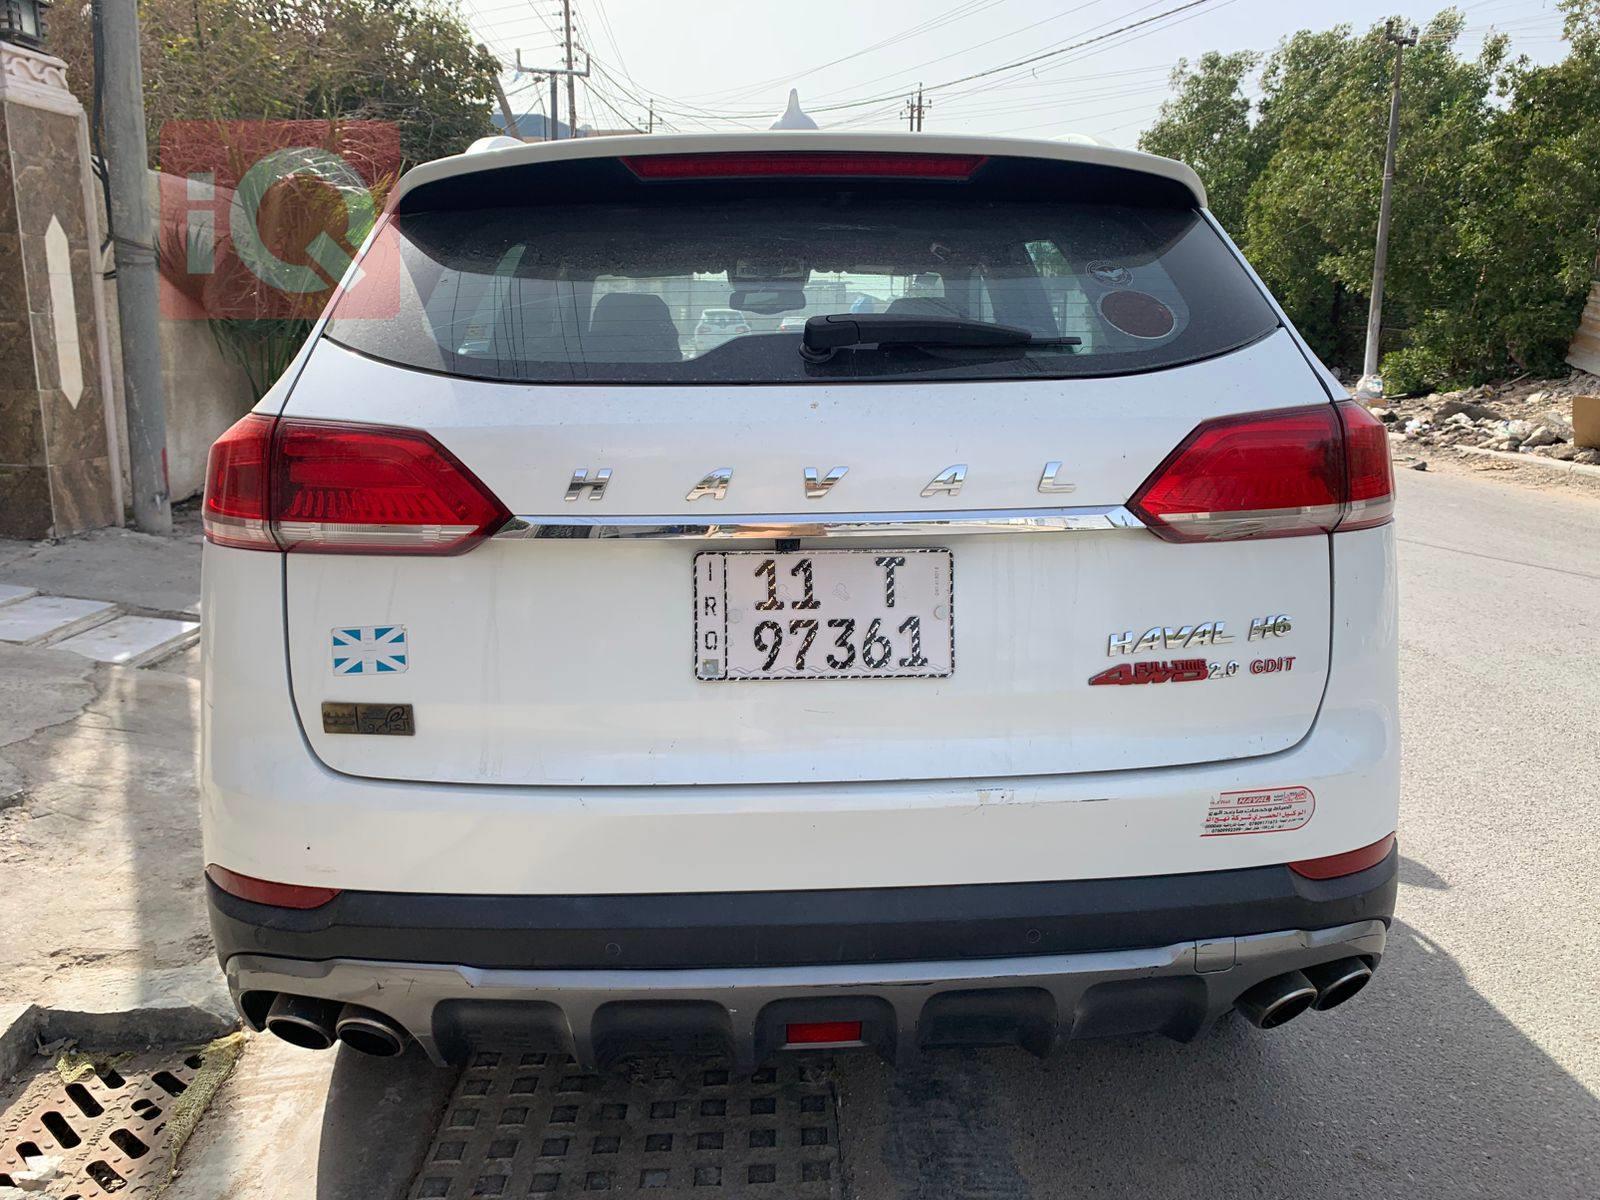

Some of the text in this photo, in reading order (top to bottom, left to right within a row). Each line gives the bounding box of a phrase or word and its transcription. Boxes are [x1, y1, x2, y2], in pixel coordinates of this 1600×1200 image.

[564, 461, 1078, 502] HAVAL
[754, 557, 822, 611] 11
[875, 556, 906, 608] T
[753, 615, 929, 671] 97361
[1107, 613, 1294, 657] HAVAL H6
[1207, 659, 1240, 680] 2.0
[1250, 656, 1296, 675] GDIT
